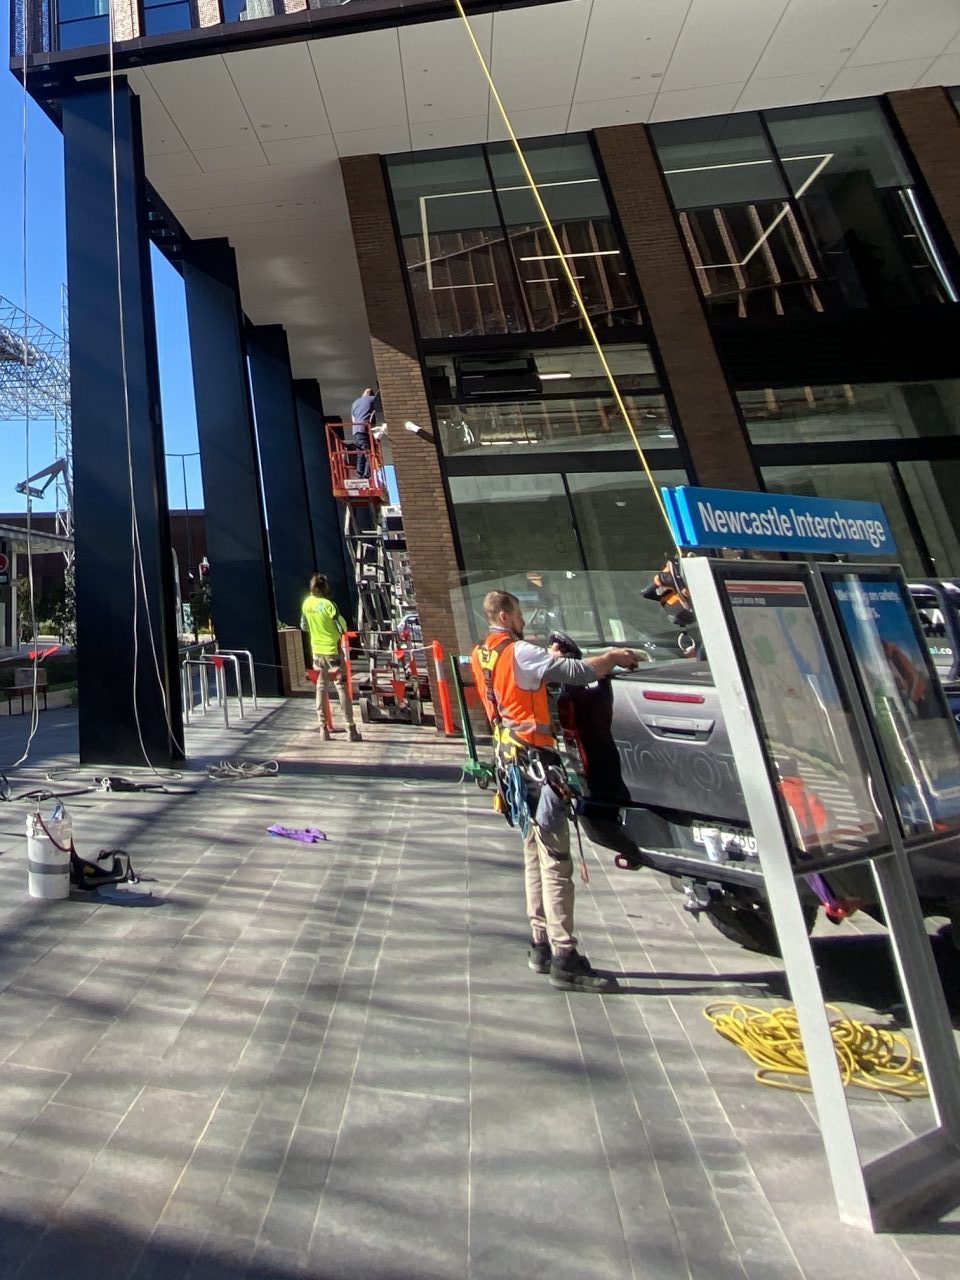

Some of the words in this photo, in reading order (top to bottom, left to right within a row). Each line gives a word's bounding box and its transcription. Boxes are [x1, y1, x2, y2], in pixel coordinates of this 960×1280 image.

[697, 501, 794, 537] Newcastle
[790, 508, 887, 549] Interchange
[614, 739, 742, 796] TOYOT
